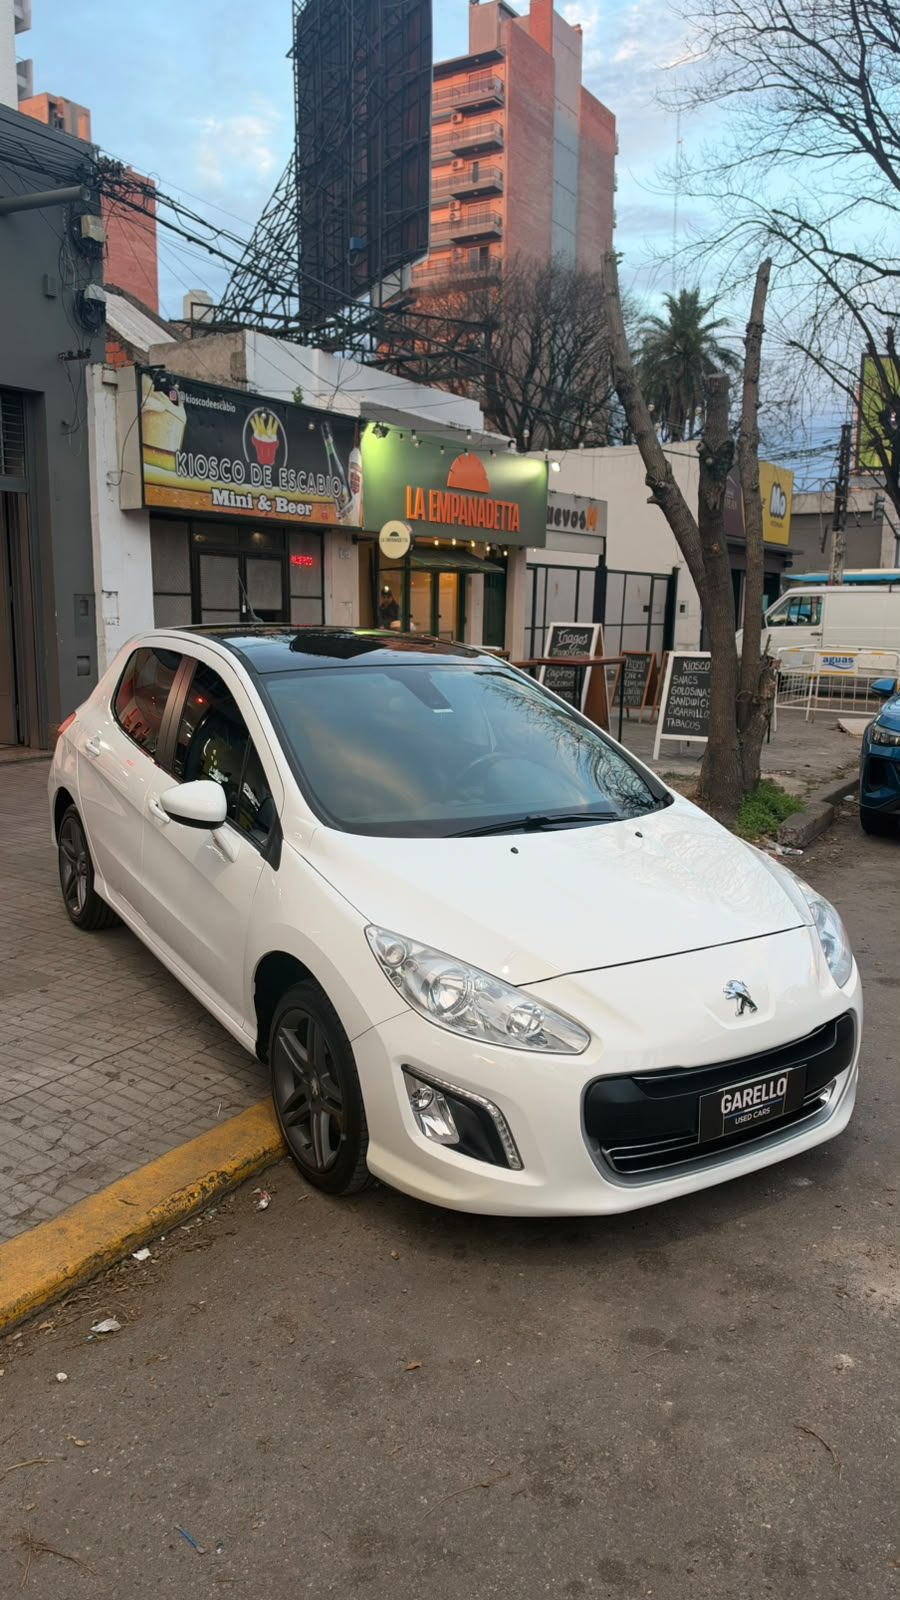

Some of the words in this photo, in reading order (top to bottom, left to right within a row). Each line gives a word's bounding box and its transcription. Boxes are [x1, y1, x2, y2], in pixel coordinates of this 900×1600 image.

[179, 391, 236, 413] @kioscodeescabio
[175, 451, 247, 483] KIOSCO
[250, 463, 273, 488] DE
[279, 470, 342, 498] ESCABIO
[211, 488, 253, 510] Mini
[254, 496, 272, 512] &
[275, 497, 313, 517] Beer
[406, 485, 426, 521] LA
[429, 489, 521, 532] EMPANADETTA
[556, 629, 589, 650] Tragos
[683, 660, 711, 671] KIOSCO
[821, 655, 854, 667] aguas
[673, 674, 699, 685] SNACS
[668, 706, 710, 719] CIGARRILLO
[667, 718, 702, 731] TABACOS
[721, 1077, 788, 1115] GARELLO
[734, 1112, 753, 1125] USED
[753, 1107, 771, 1121] CARS
